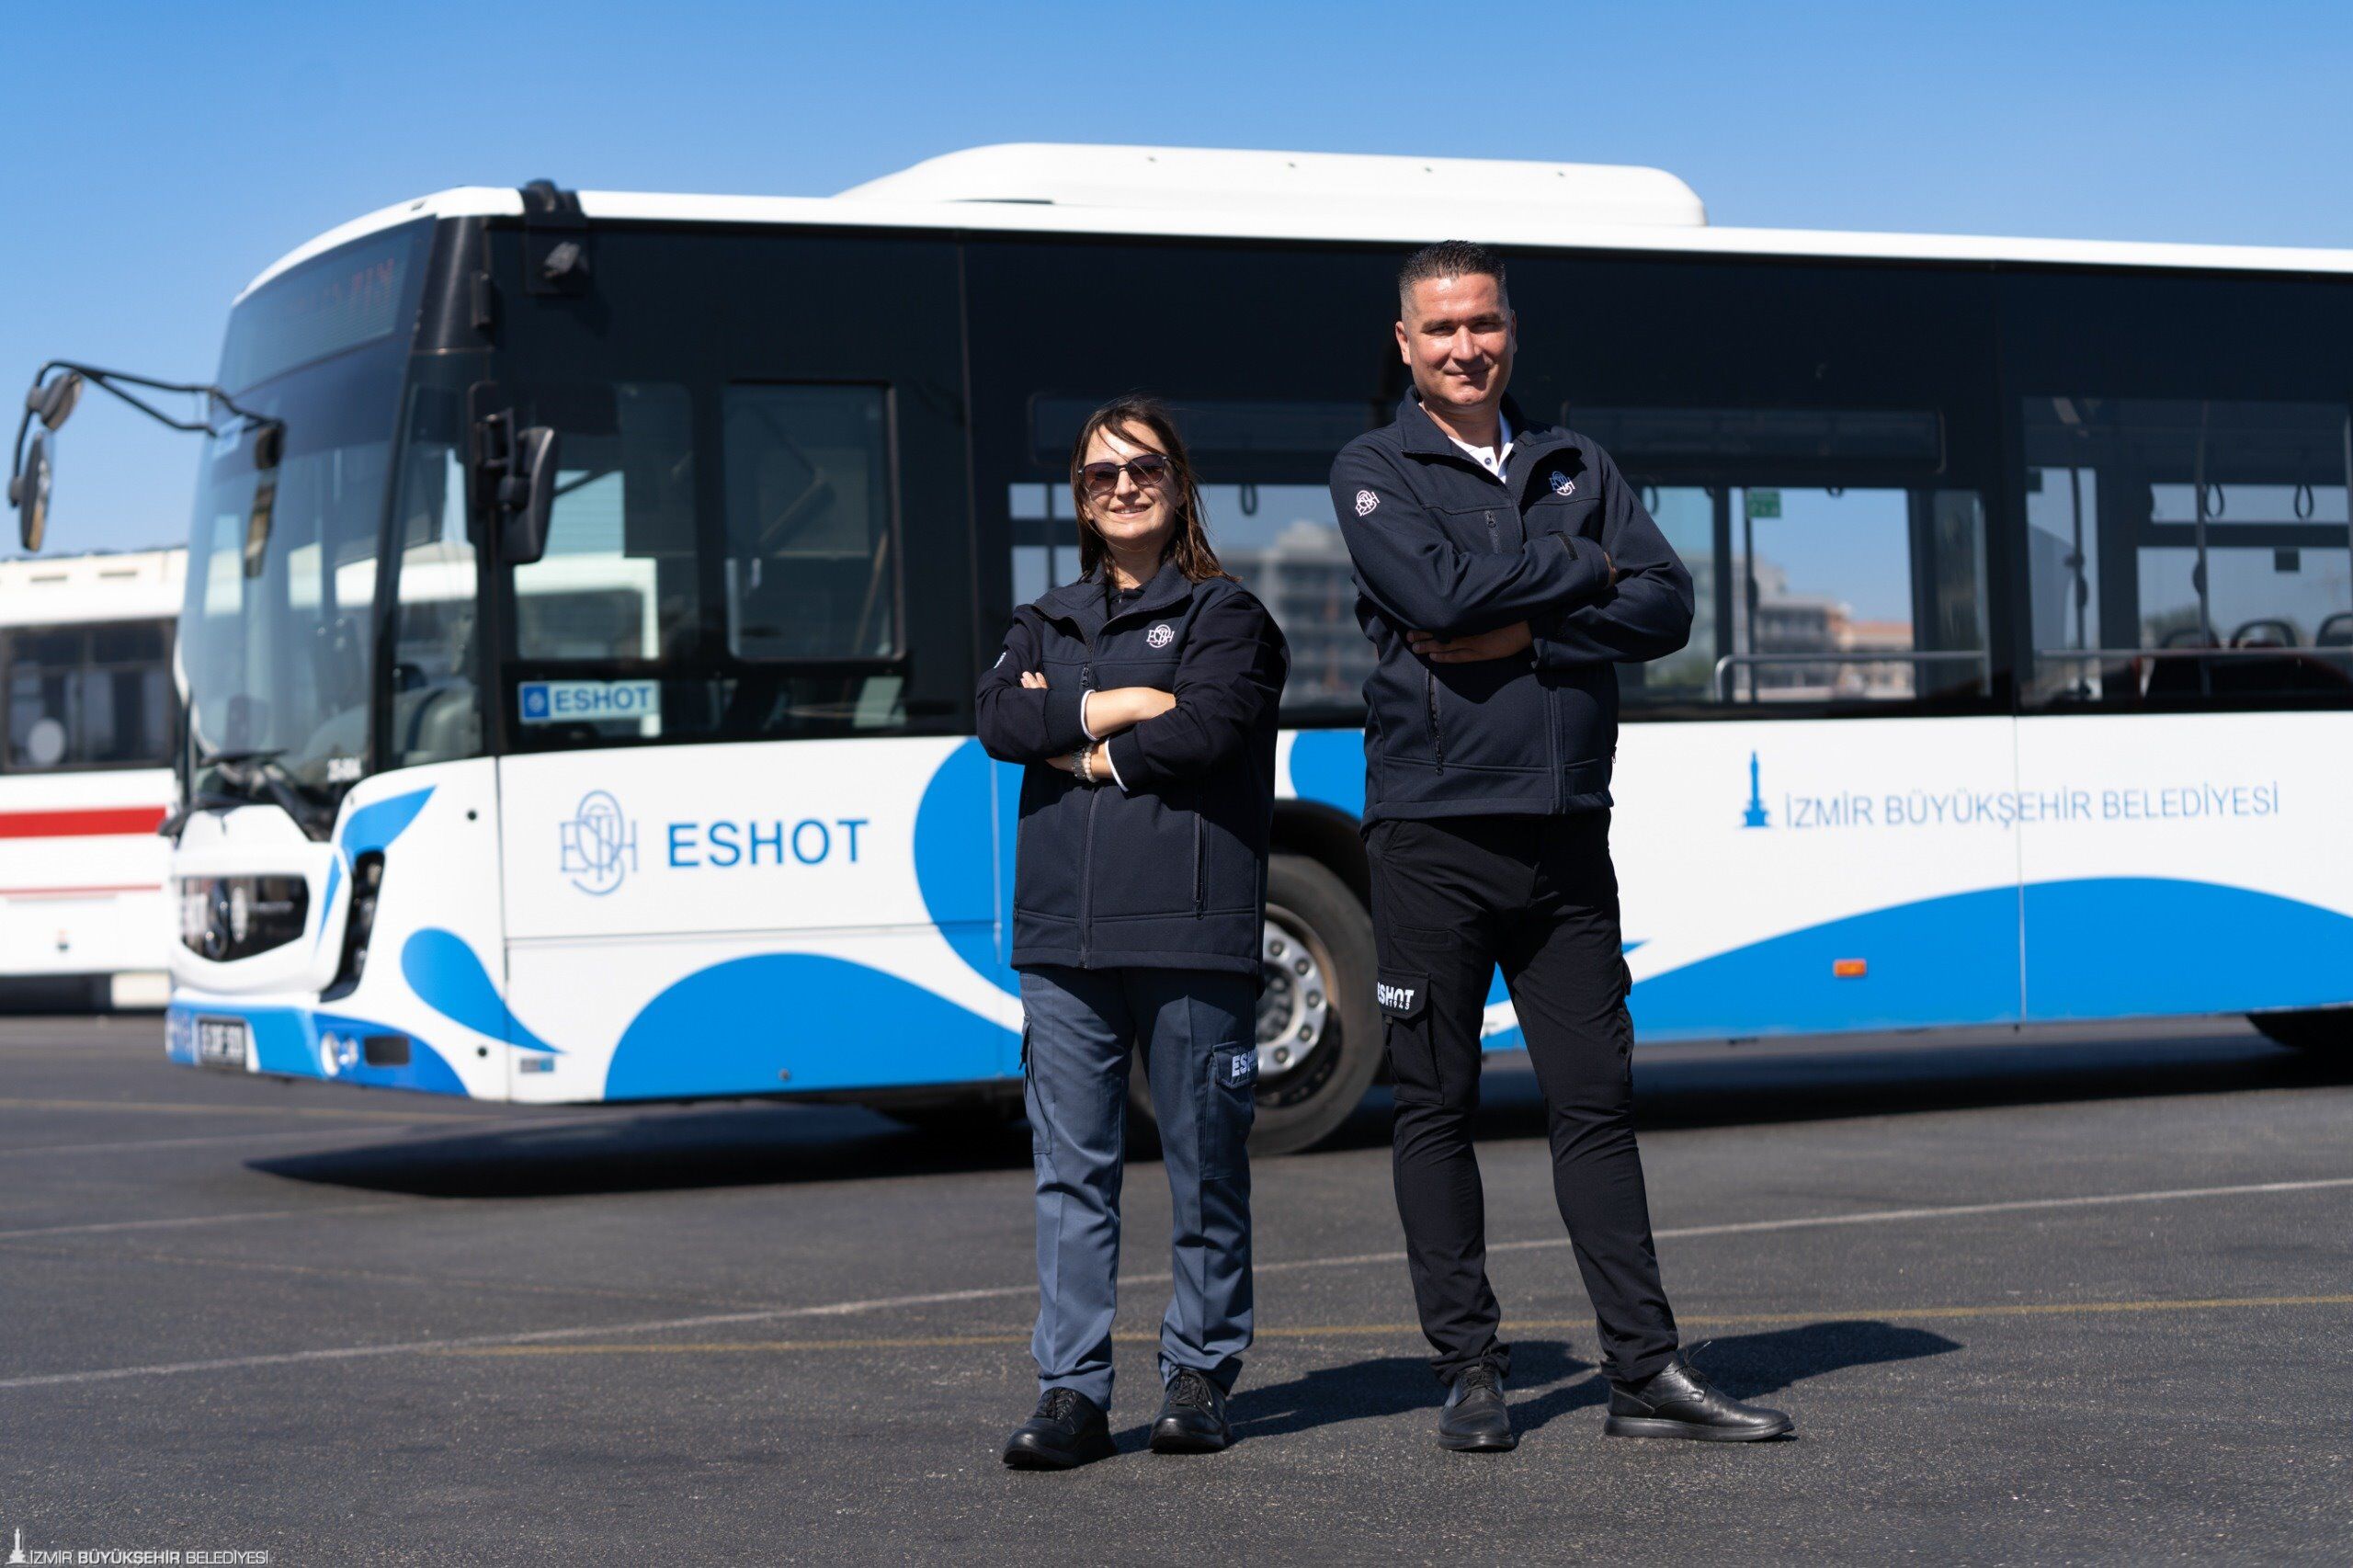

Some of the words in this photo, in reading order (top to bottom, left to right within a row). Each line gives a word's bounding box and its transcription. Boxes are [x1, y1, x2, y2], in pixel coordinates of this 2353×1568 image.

[554, 687, 652, 712] ESHOT
[1785, 790, 1874, 828] İZMİR
[1885, 785, 2092, 831] BÜYÜKŞEHİR
[2102, 780, 2279, 820] BELEDİYESİ
[667, 818, 870, 868] ESHOT
